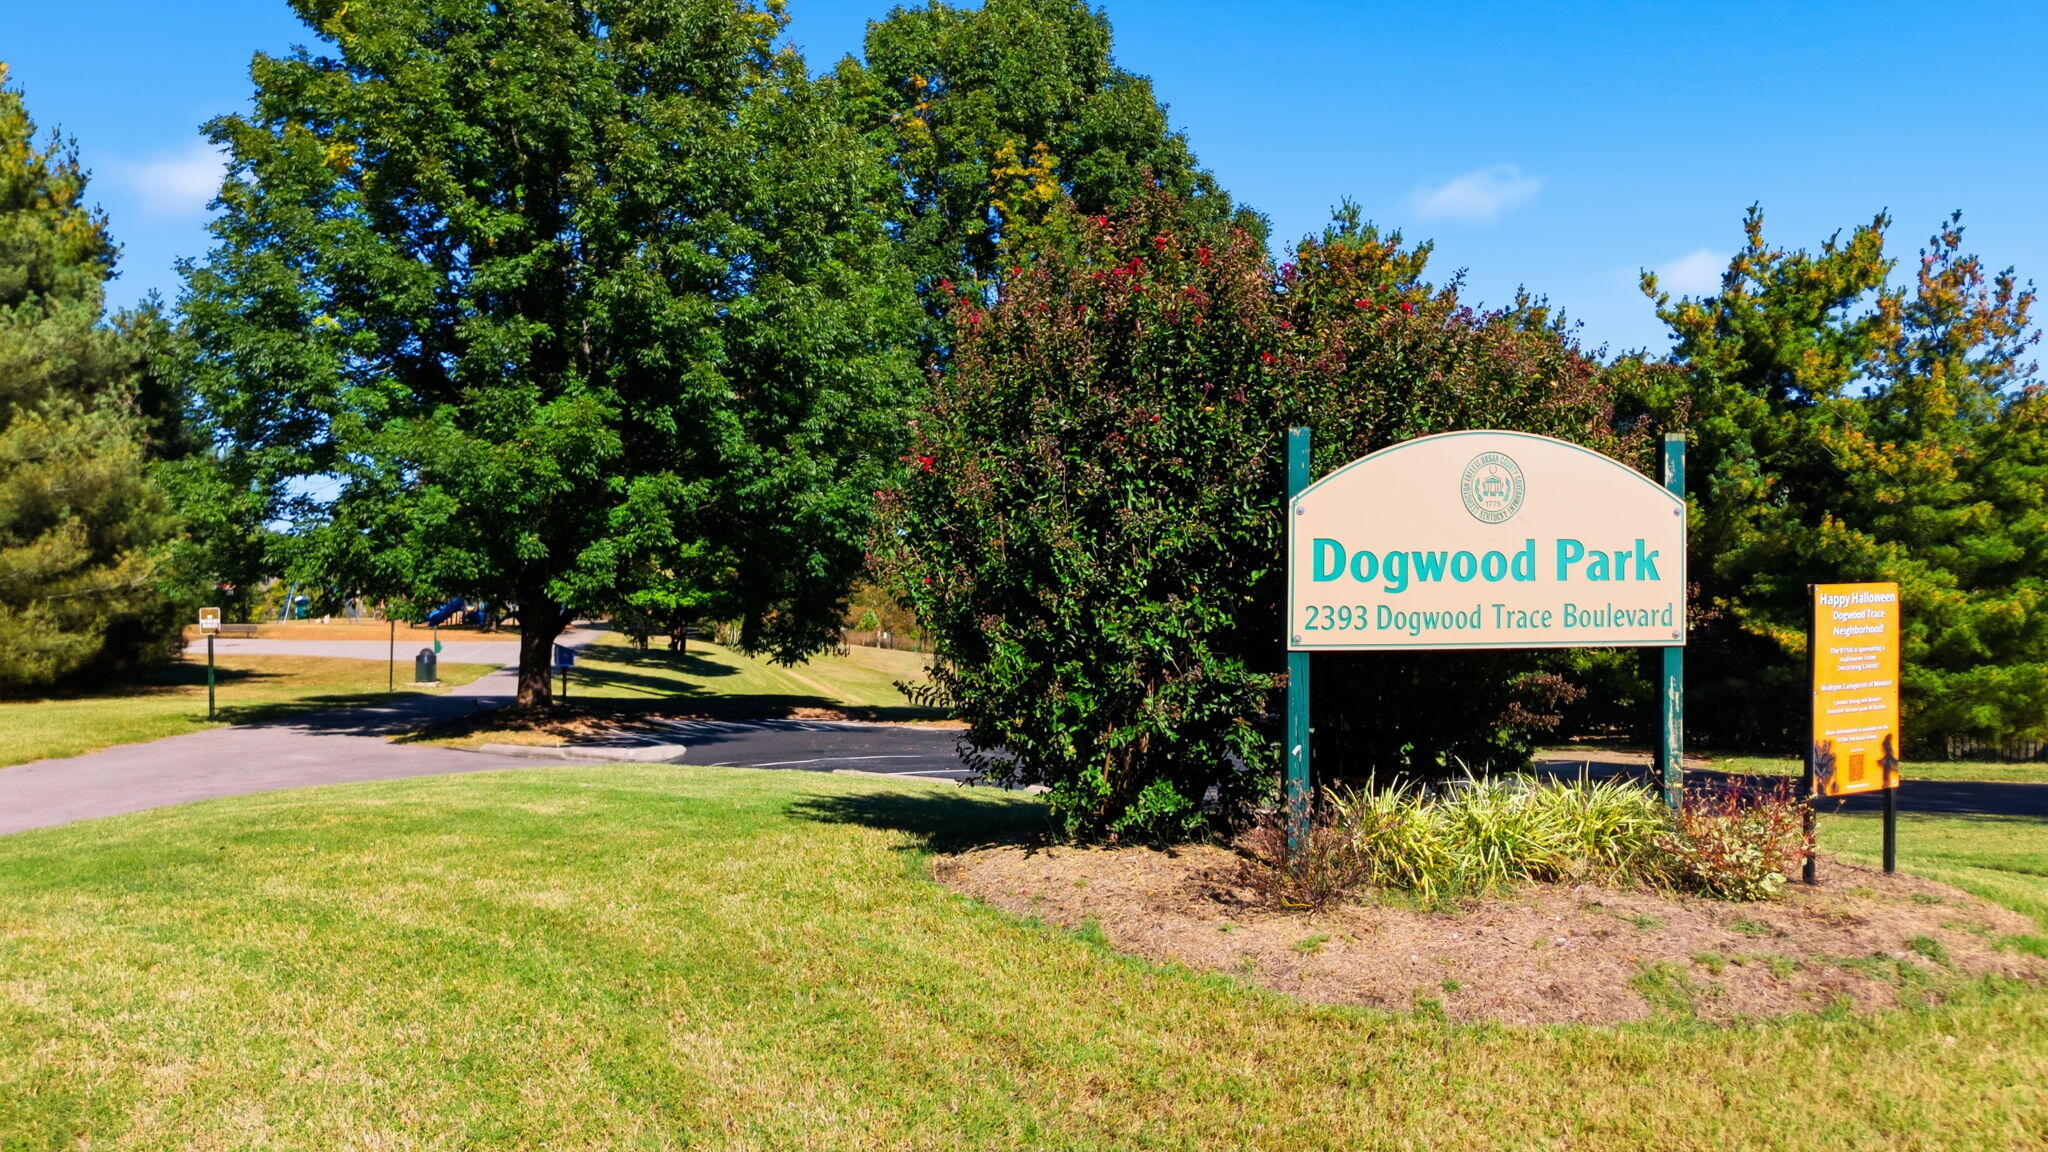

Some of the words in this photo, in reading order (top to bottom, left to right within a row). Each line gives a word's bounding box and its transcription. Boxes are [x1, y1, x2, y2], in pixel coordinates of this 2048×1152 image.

[1313, 538, 1536, 593] Dogwood
[1556, 538, 1661, 582] Park
[1820, 593, 1850, 608] Happy
[1851, 591, 1896, 604] Halloween
[1304, 605, 1369, 631] 2393
[1376, 604, 1482, 637] Dogwood
[1491, 603, 1553, 629] Trace
[1563, 602, 1673, 629] Boulevard
[1833, 610, 1866, 622] Dogwood
[1867, 609, 1885, 618] Trace
